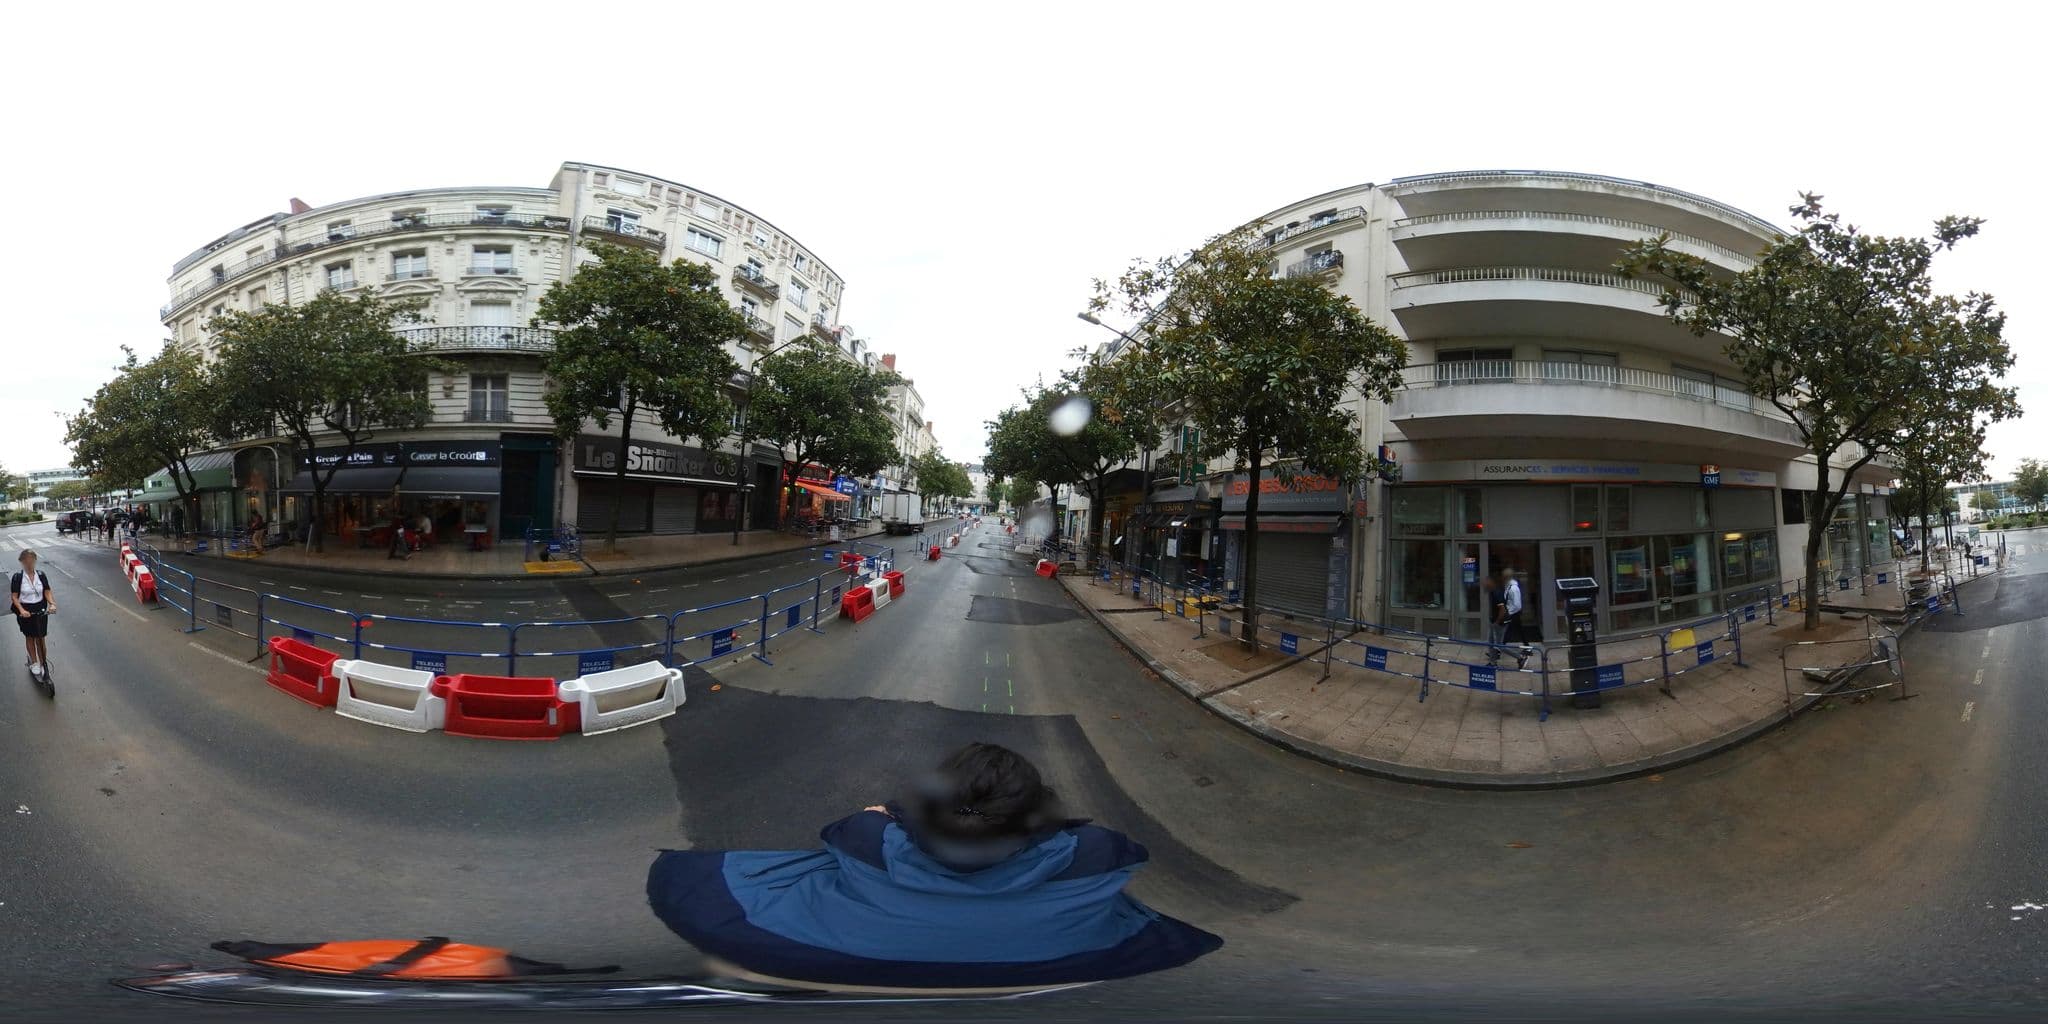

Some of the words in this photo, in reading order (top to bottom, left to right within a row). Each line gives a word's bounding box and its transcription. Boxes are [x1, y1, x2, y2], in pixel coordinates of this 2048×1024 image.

[410, 452, 437, 461] Casser
[439, 451, 448, 460] la
[585, 445, 616, 469] Le
[1483, 465, 1542, 473] ASSURANCES
[1703, 476, 1720, 485] GMF
